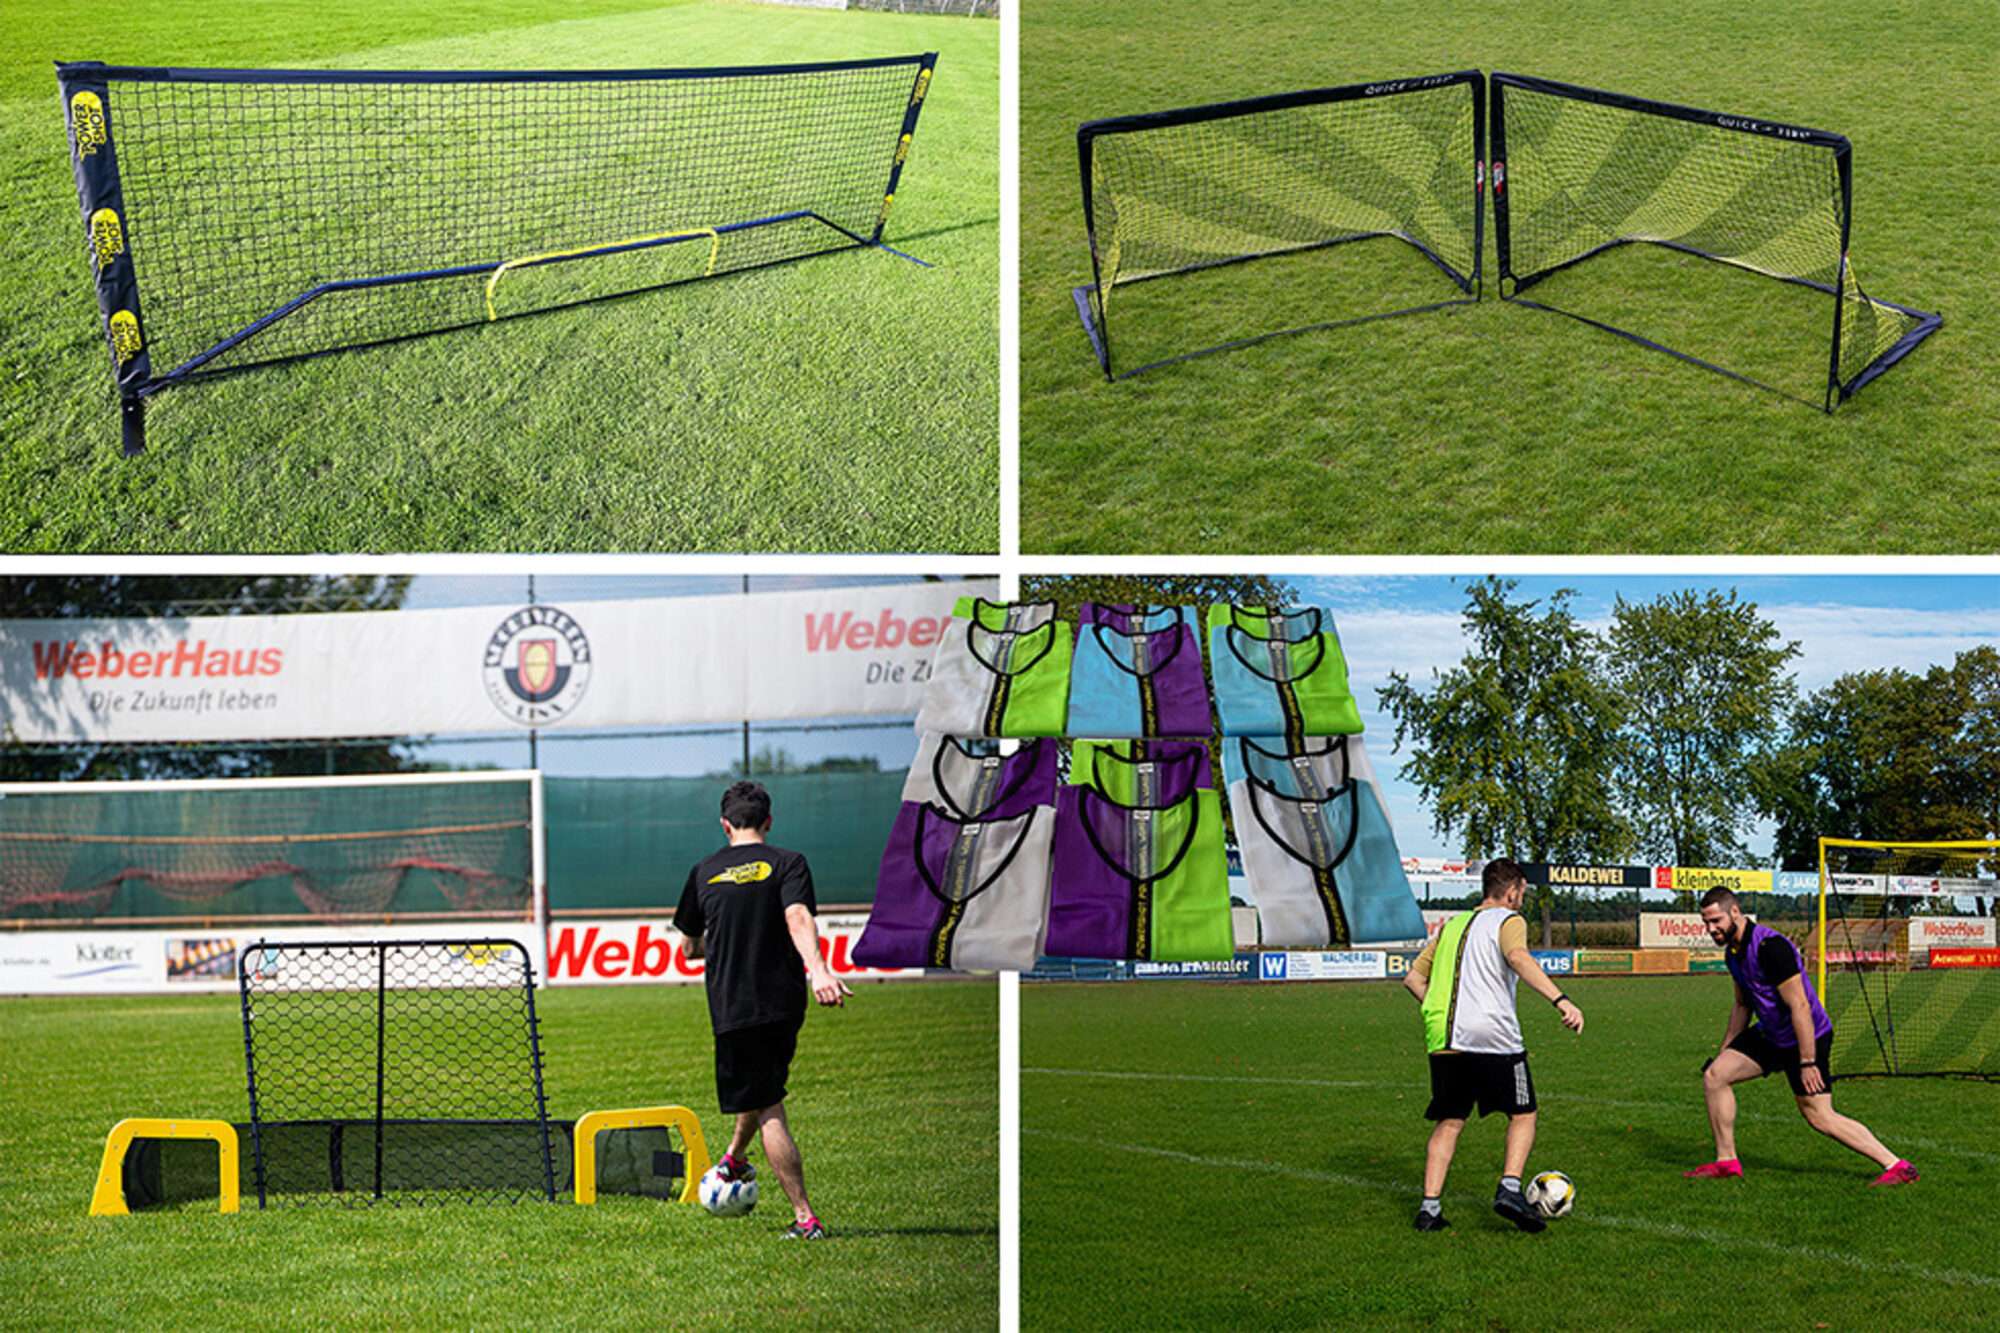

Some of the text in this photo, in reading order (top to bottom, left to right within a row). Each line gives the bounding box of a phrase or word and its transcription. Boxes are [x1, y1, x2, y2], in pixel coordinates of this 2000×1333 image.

[73, 103, 97, 153] POWER
[88, 104, 105, 145] SHOT
[1717, 115, 1757, 131] QUICK
[32, 639, 284, 681] WeberHaus
[866, 661, 904, 684] Die
[88, 690, 278, 713] Die Zukunft leben
[1548, 865, 1624, 885] KALDEWEI
[1677, 870, 1742, 889] kleinhans
[1265, 957, 1285, 976] W
